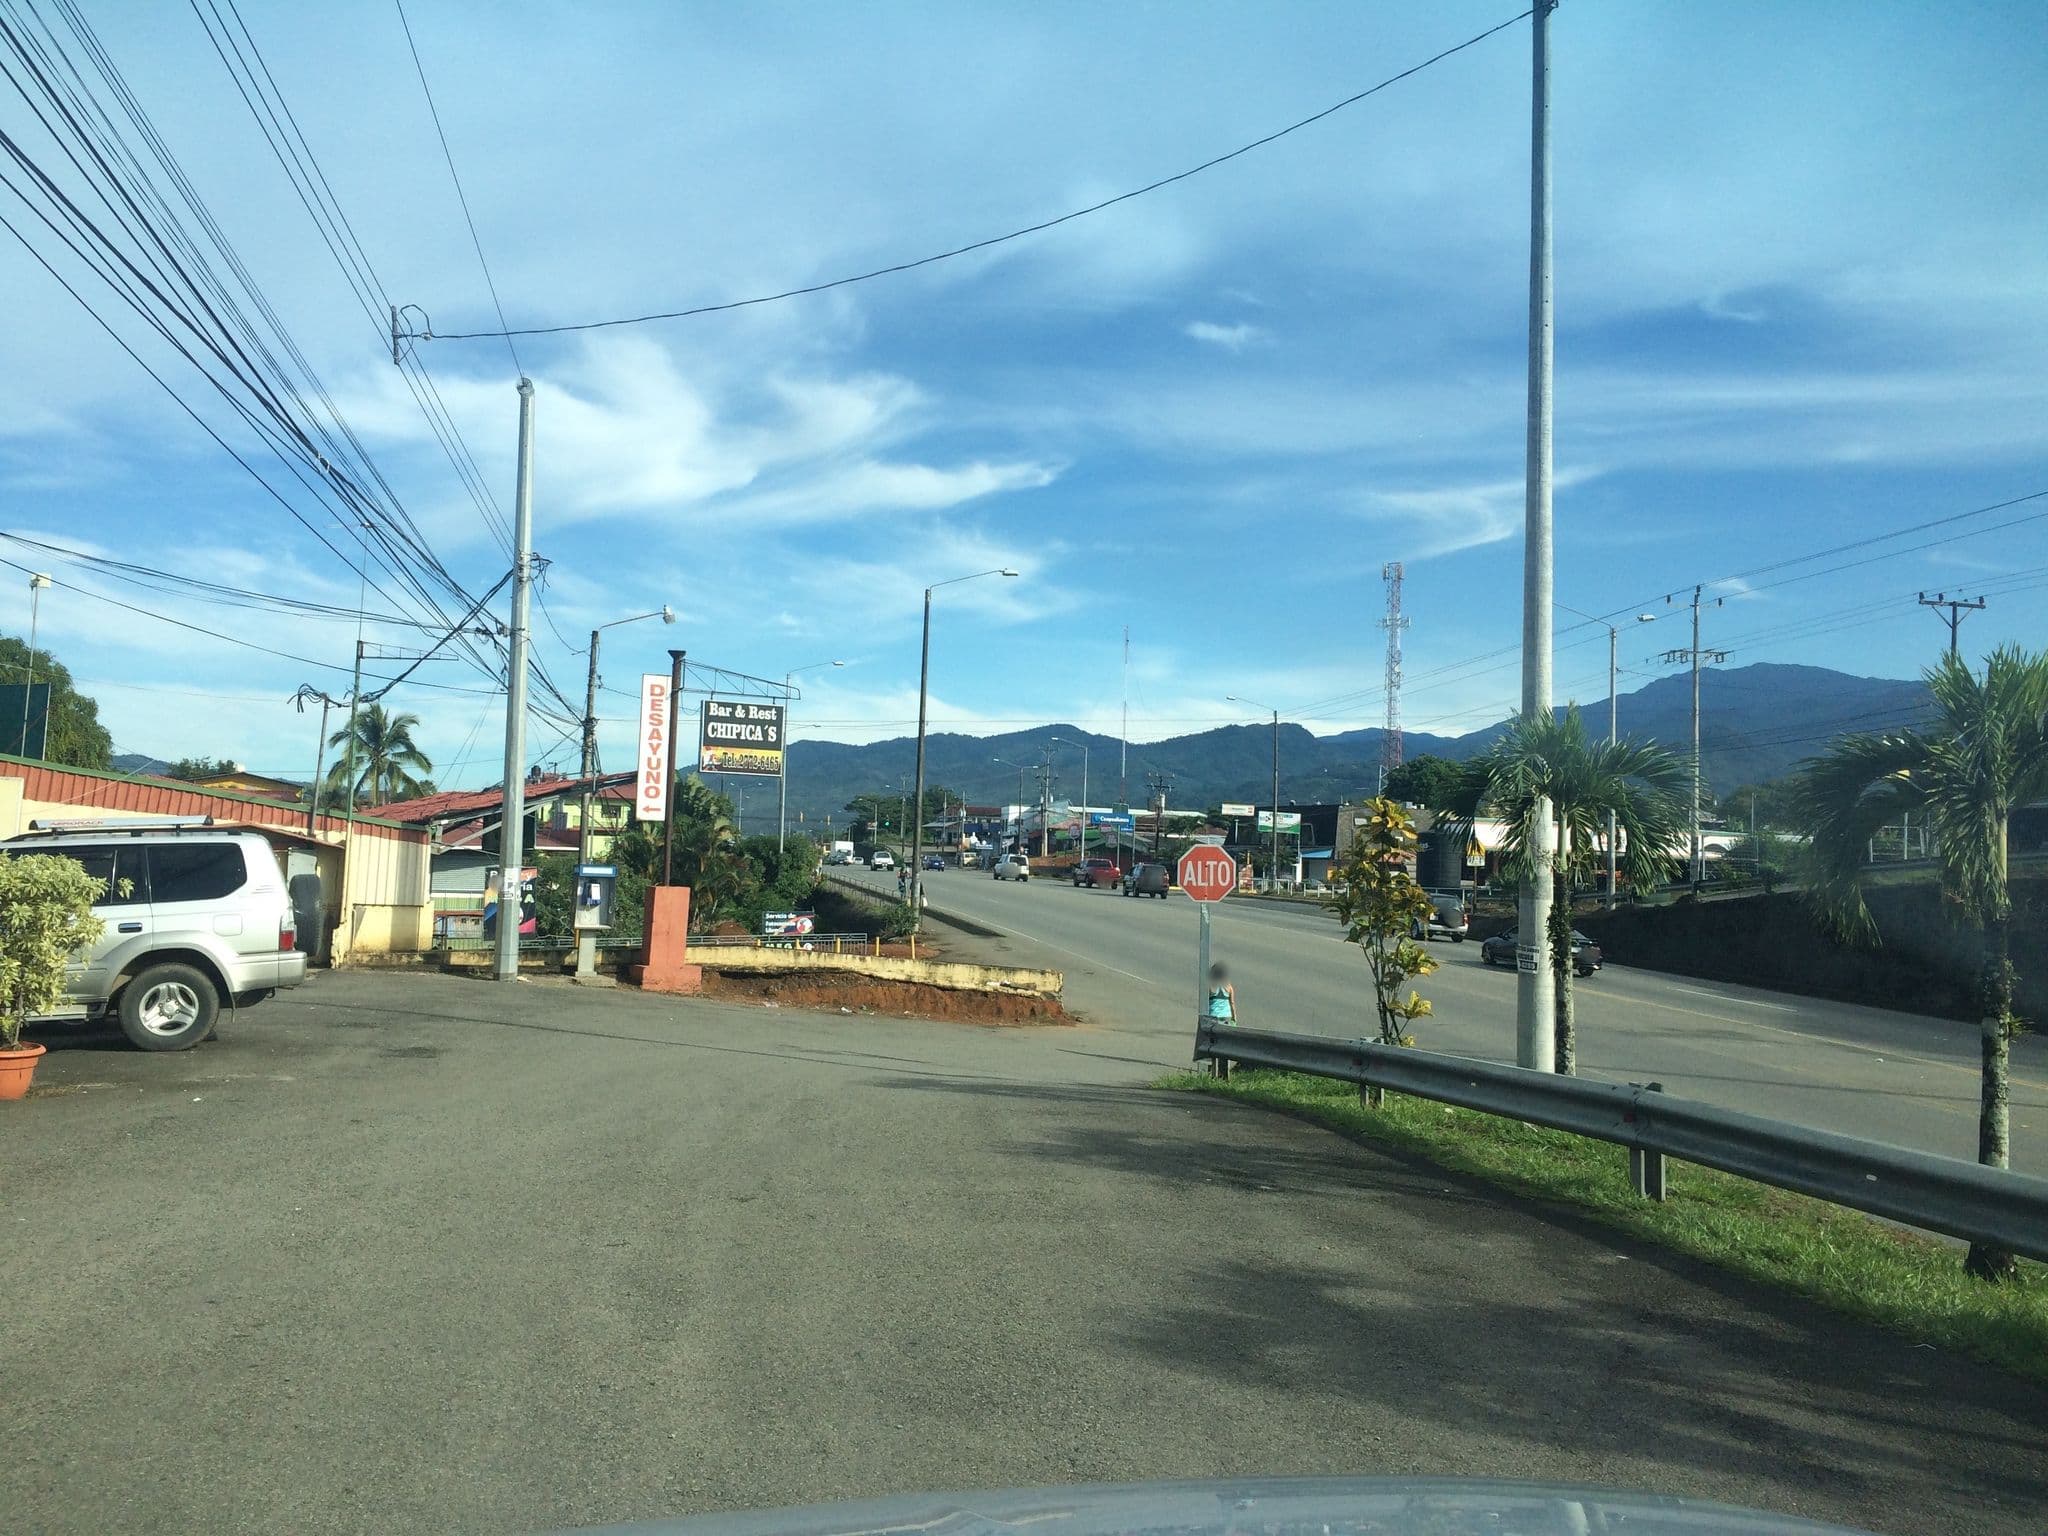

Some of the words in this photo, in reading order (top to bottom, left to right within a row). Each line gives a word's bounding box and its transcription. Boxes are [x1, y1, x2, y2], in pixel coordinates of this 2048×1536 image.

[709, 702, 732, 717] Bar
[734, 704, 746, 718] &
[748, 705, 777, 720] Rest
[644, 684, 666, 799] DESAYUNO
[1183, 860, 1231, 887] ALTO
